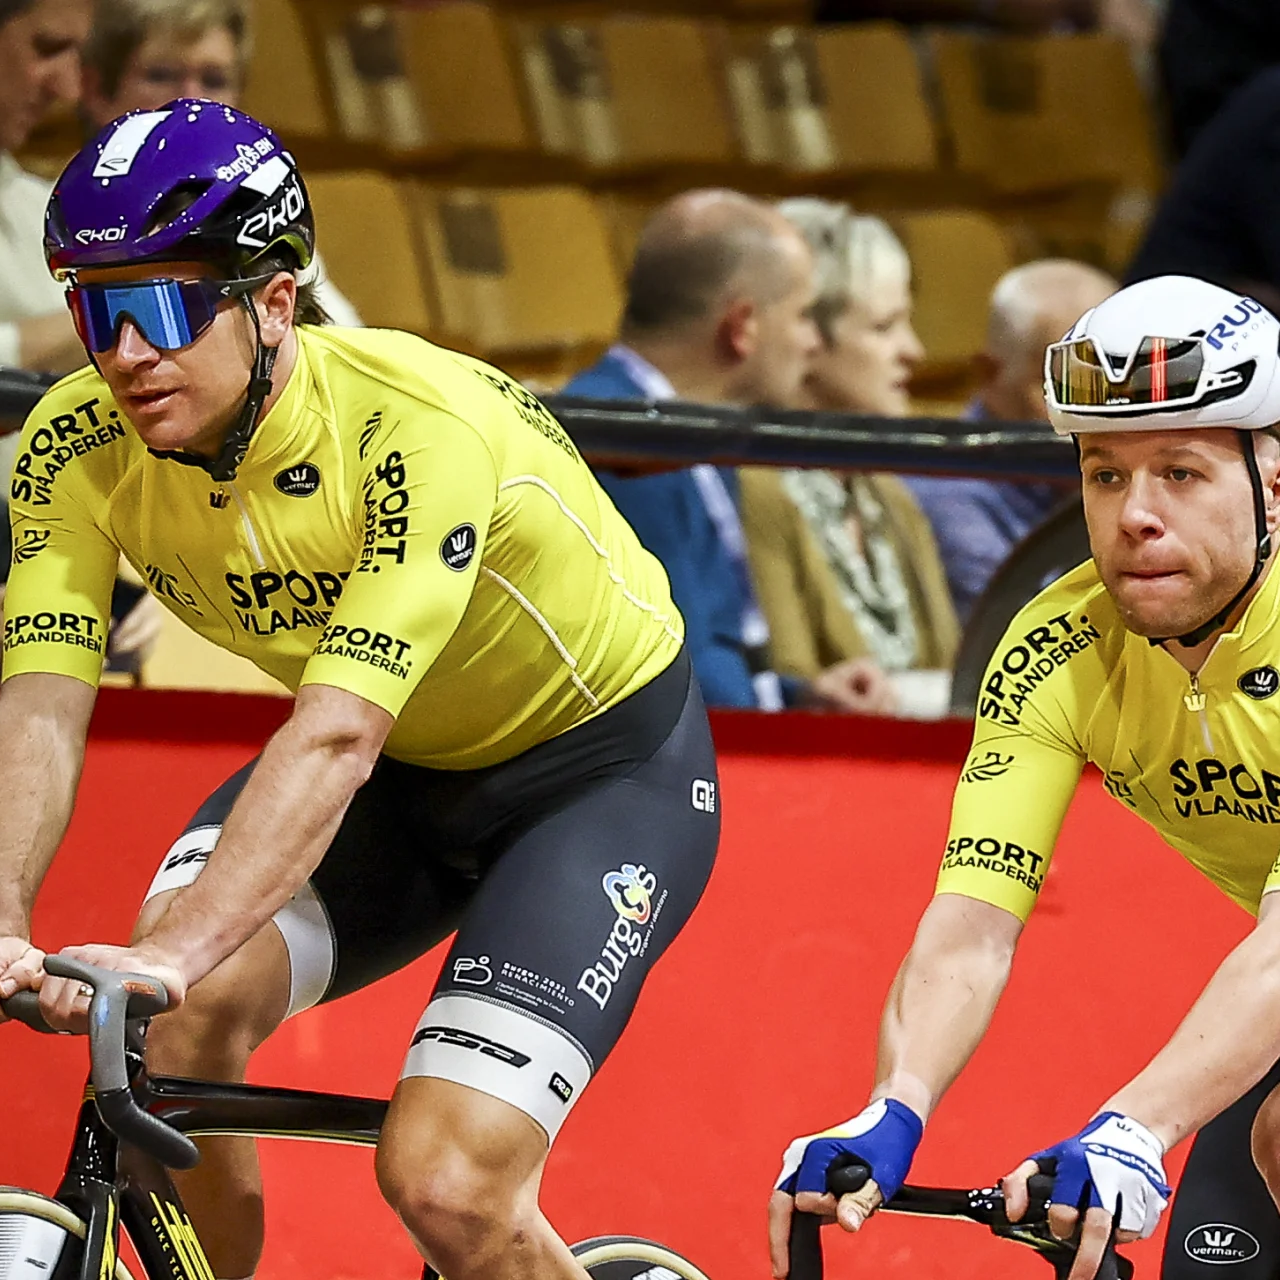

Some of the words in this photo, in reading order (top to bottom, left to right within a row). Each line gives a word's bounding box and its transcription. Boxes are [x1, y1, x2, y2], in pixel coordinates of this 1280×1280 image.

[10, 397, 120, 503] SPORT.
[4, 611, 104, 642] SPORT.
[318, 624, 414, 667] SPORT.
[979, 610, 1089, 721] SPORT.
[150, 1216, 170, 1253] BIKE
[1192, 1245, 1246, 1258] vermarc
